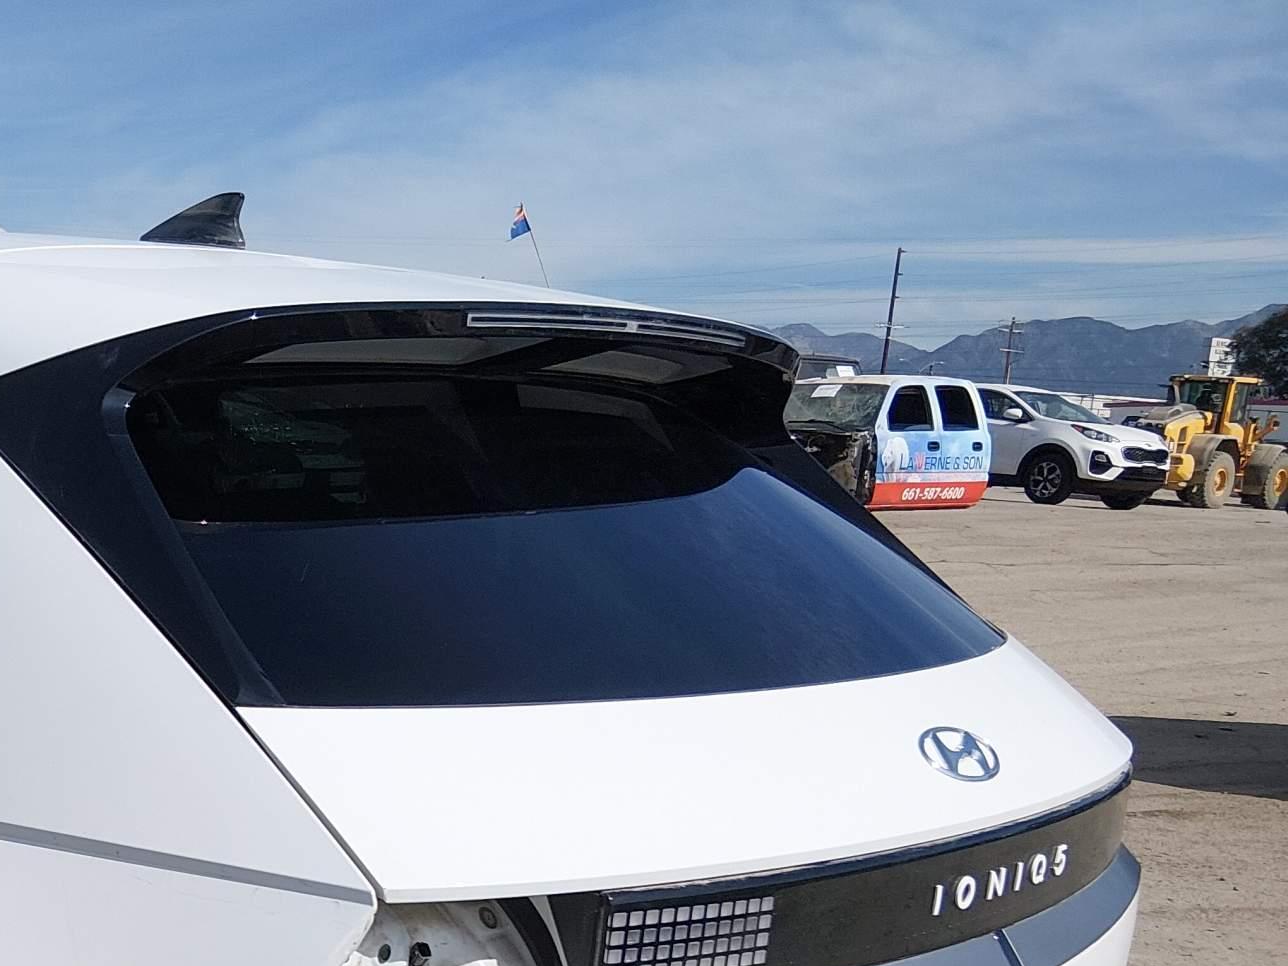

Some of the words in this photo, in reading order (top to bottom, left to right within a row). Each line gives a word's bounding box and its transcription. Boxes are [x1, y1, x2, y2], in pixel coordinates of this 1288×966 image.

[953, 457, 960, 470] &
[962, 457, 984, 470] SON
[902, 487, 965, 500] 661-587-6600
